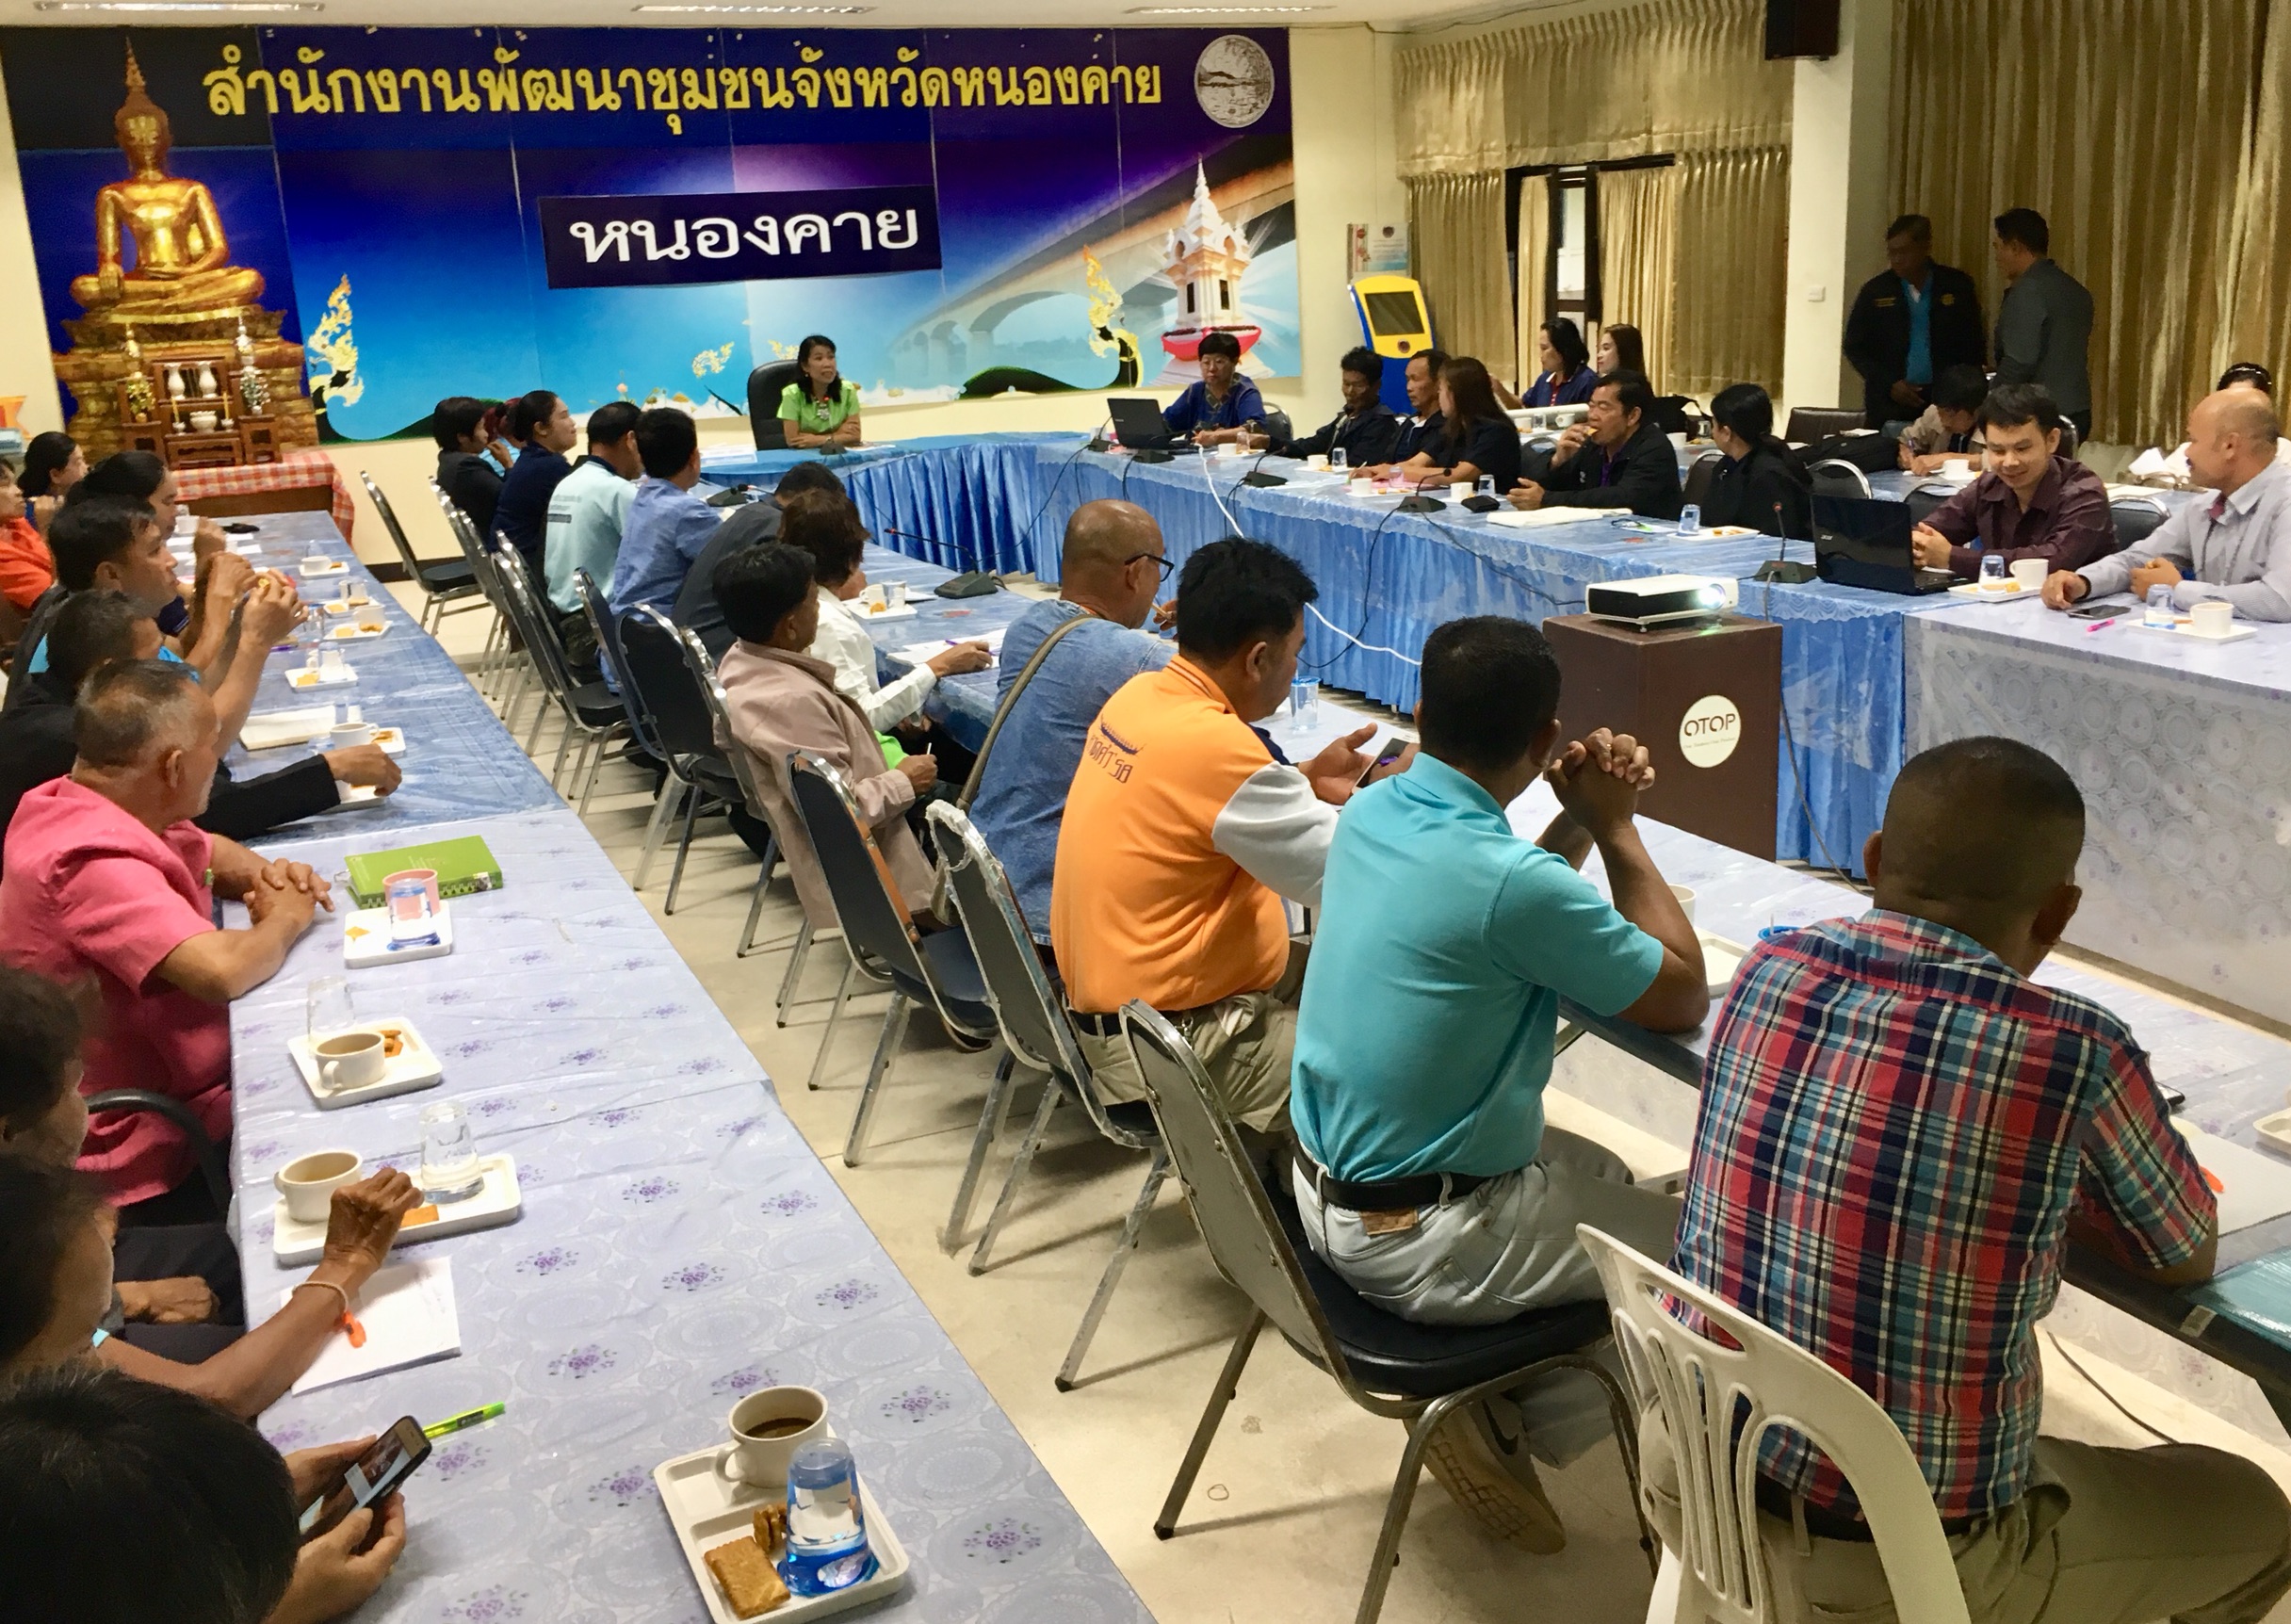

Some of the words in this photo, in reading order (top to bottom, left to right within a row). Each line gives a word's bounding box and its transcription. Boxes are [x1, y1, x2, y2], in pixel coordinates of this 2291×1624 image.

[203, 43, 1162, 135] สำนักงานพัฒนาชุมชนจังหวัดหนองคาย
[569, 208, 919, 263] หนองคาย
[1683, 713, 1736, 737] OTOP
